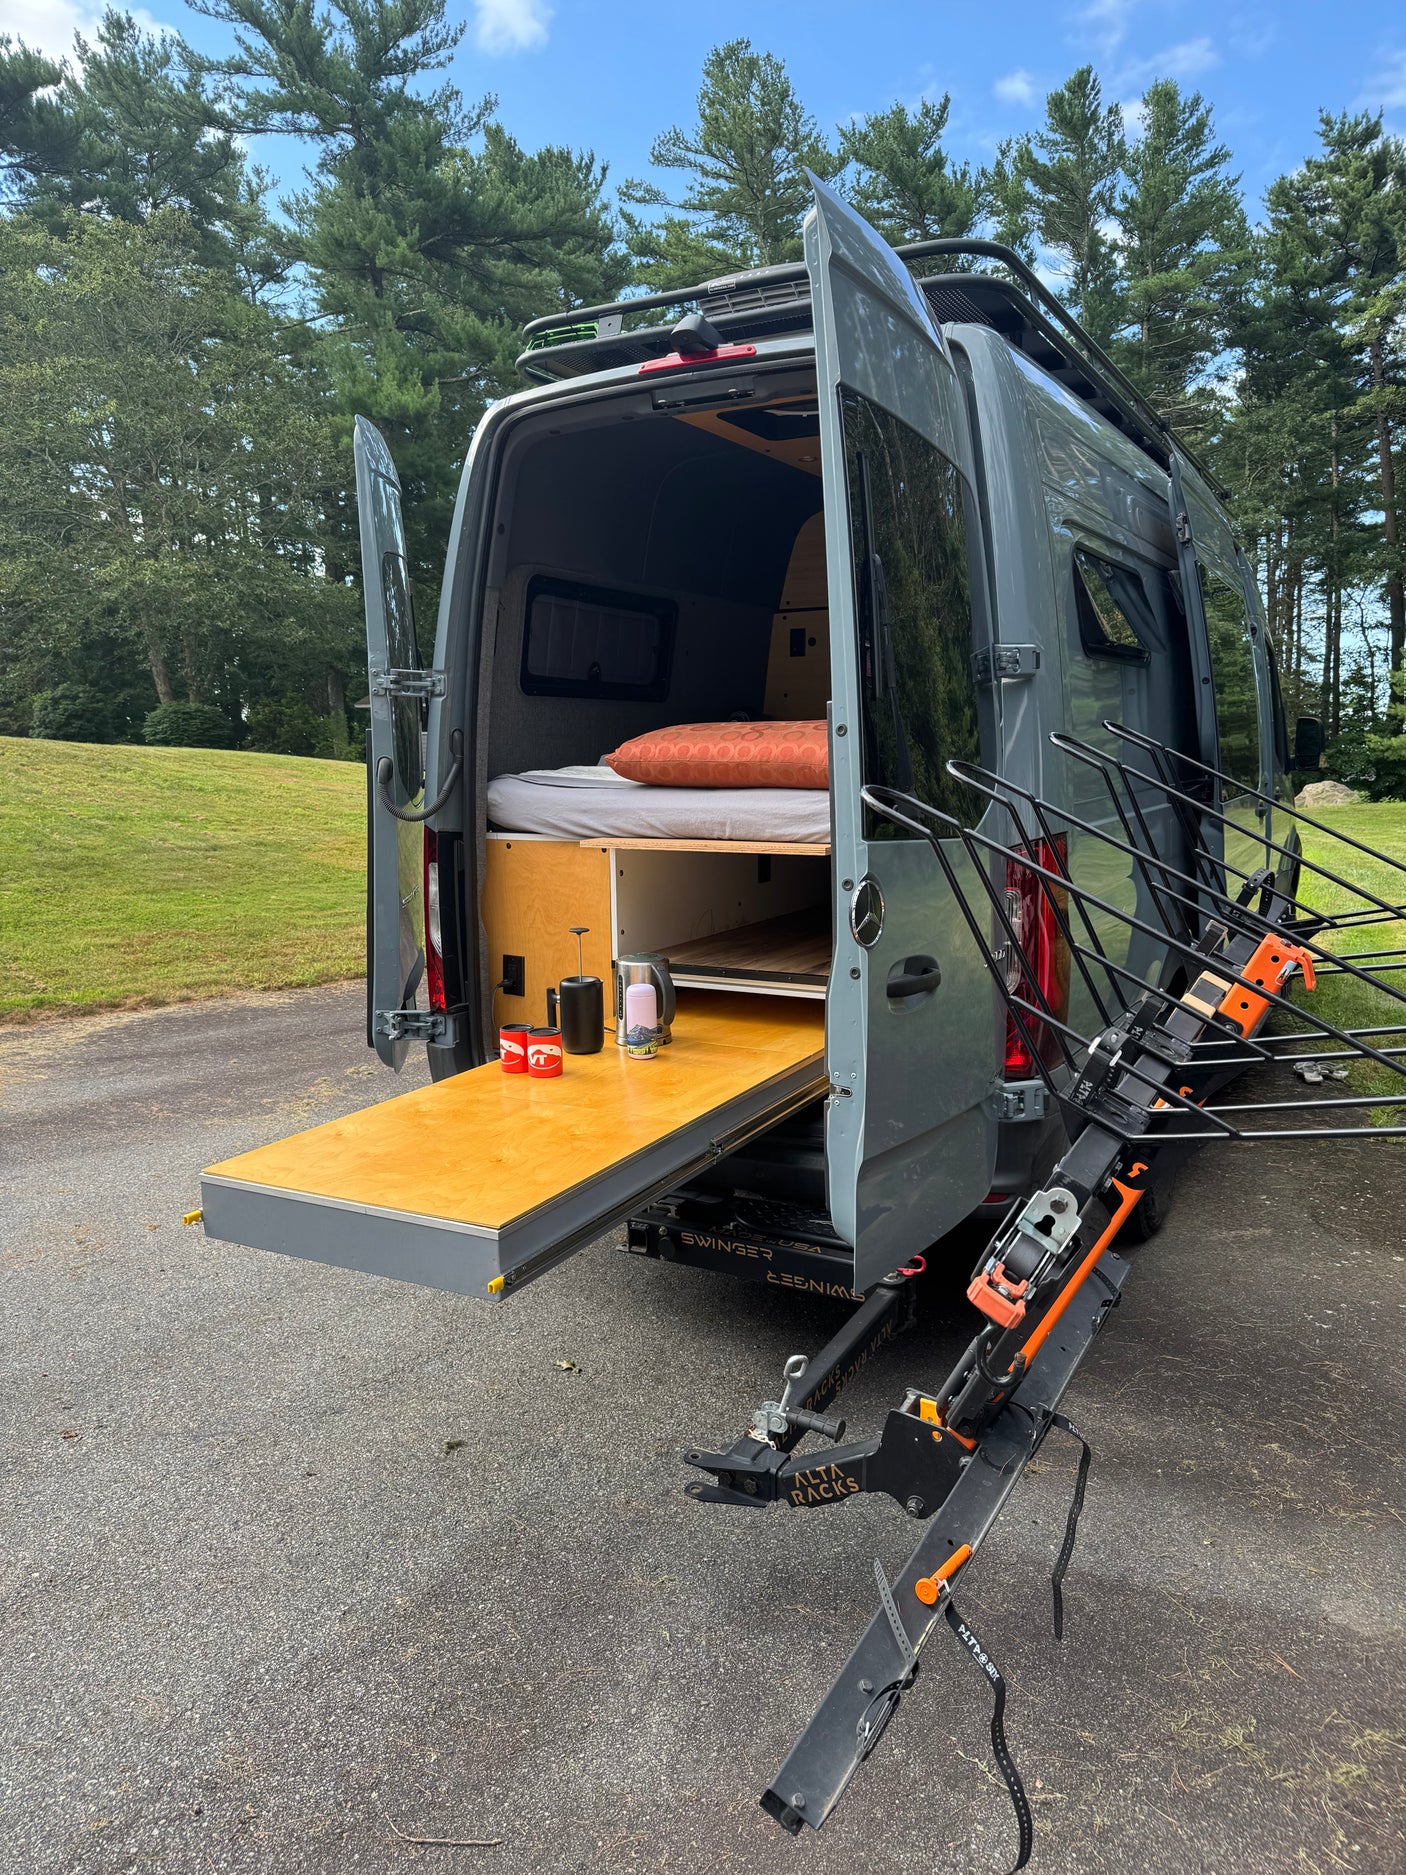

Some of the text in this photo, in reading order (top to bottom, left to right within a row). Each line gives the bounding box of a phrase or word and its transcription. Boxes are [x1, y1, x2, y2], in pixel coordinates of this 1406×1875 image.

[529, 1054, 548, 1066] VT
[681, 1231, 773, 1262] SWINGER
[778, 1239, 822, 1254] USA
[767, 1270, 866, 1302] SWINGER
[806, 1365, 841, 1411] RACKS
[795, 1463, 845, 1488] ALTA
[790, 1477, 859, 1505] RACKS
[958, 1624, 981, 1654] ALTA
